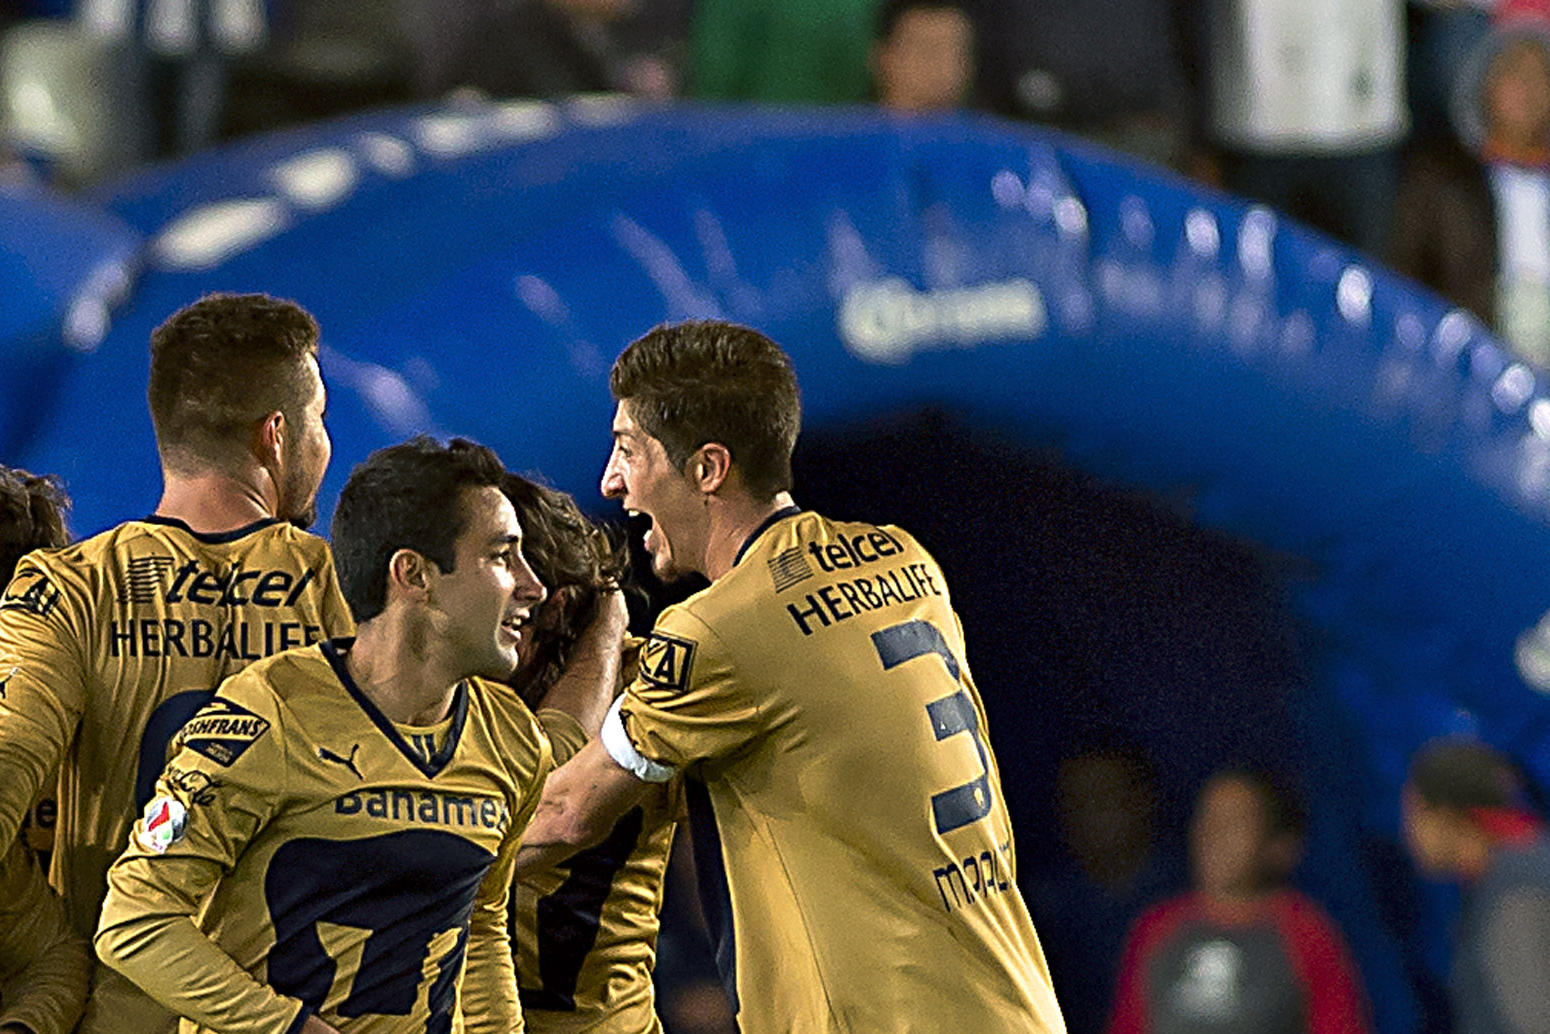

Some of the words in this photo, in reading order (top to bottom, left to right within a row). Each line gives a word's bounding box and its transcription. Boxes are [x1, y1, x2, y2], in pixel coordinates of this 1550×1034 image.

[164, 558, 316, 608] telcel
[809, 533, 904, 572] telcel
[786, 563, 941, 636] HERBALIFE
[870, 619, 992, 835] 3
